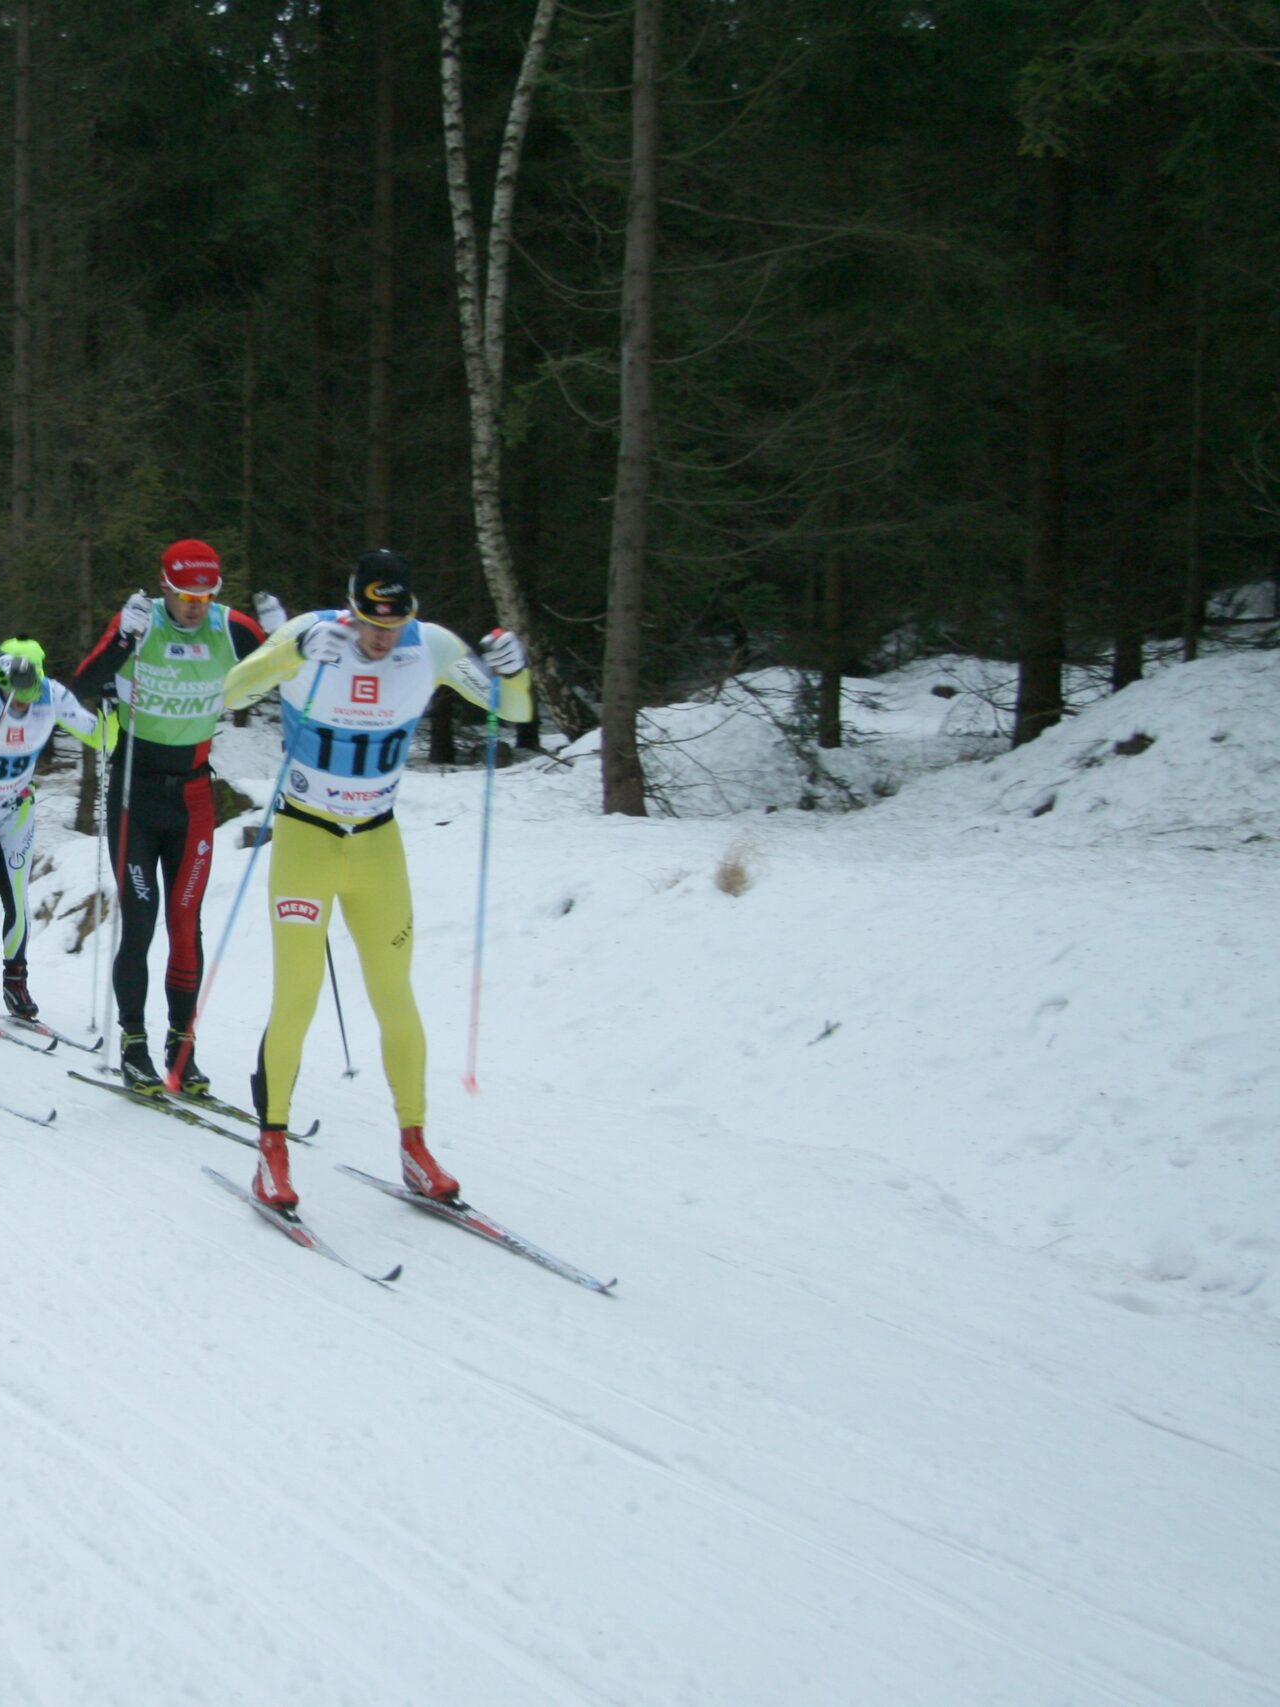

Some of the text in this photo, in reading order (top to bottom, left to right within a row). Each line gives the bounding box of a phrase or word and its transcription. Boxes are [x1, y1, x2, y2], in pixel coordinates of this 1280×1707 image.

[136, 688, 221, 716] SPRINT
[316, 727, 407, 777] 110
[180, 857, 207, 908] Santander
